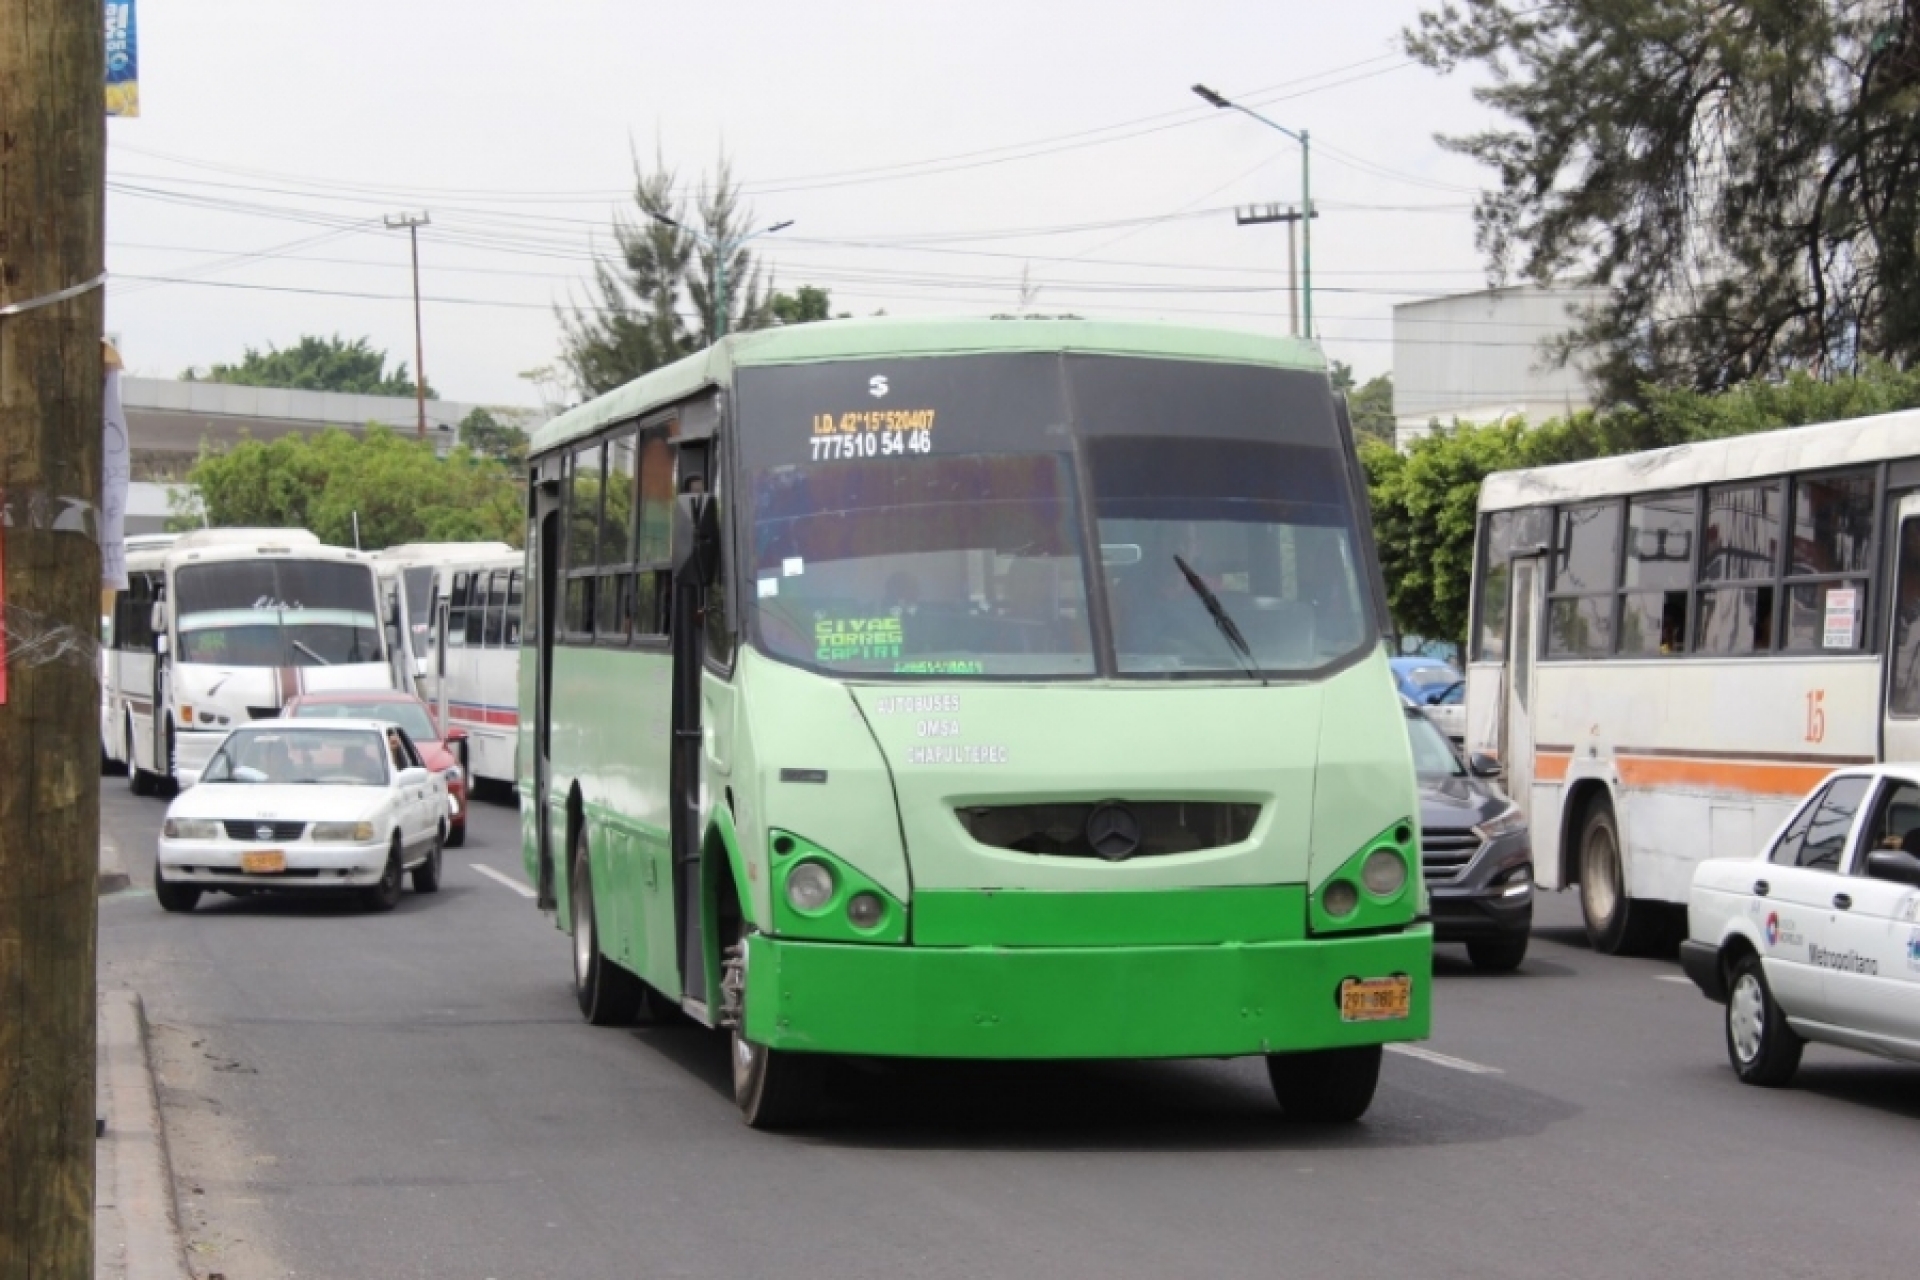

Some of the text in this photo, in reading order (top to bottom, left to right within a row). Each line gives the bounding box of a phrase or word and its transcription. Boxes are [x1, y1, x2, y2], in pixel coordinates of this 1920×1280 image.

[810, 428, 931, 460] 777510 54 46
[815, 631, 903, 647] TORRES
[877, 694, 960, 713] AUTOBUSES
[1805, 689, 1825, 743] 15
[907, 745, 1008, 764] CHAPULTEPEC
[1808, 943, 1878, 976] Metropolitano
